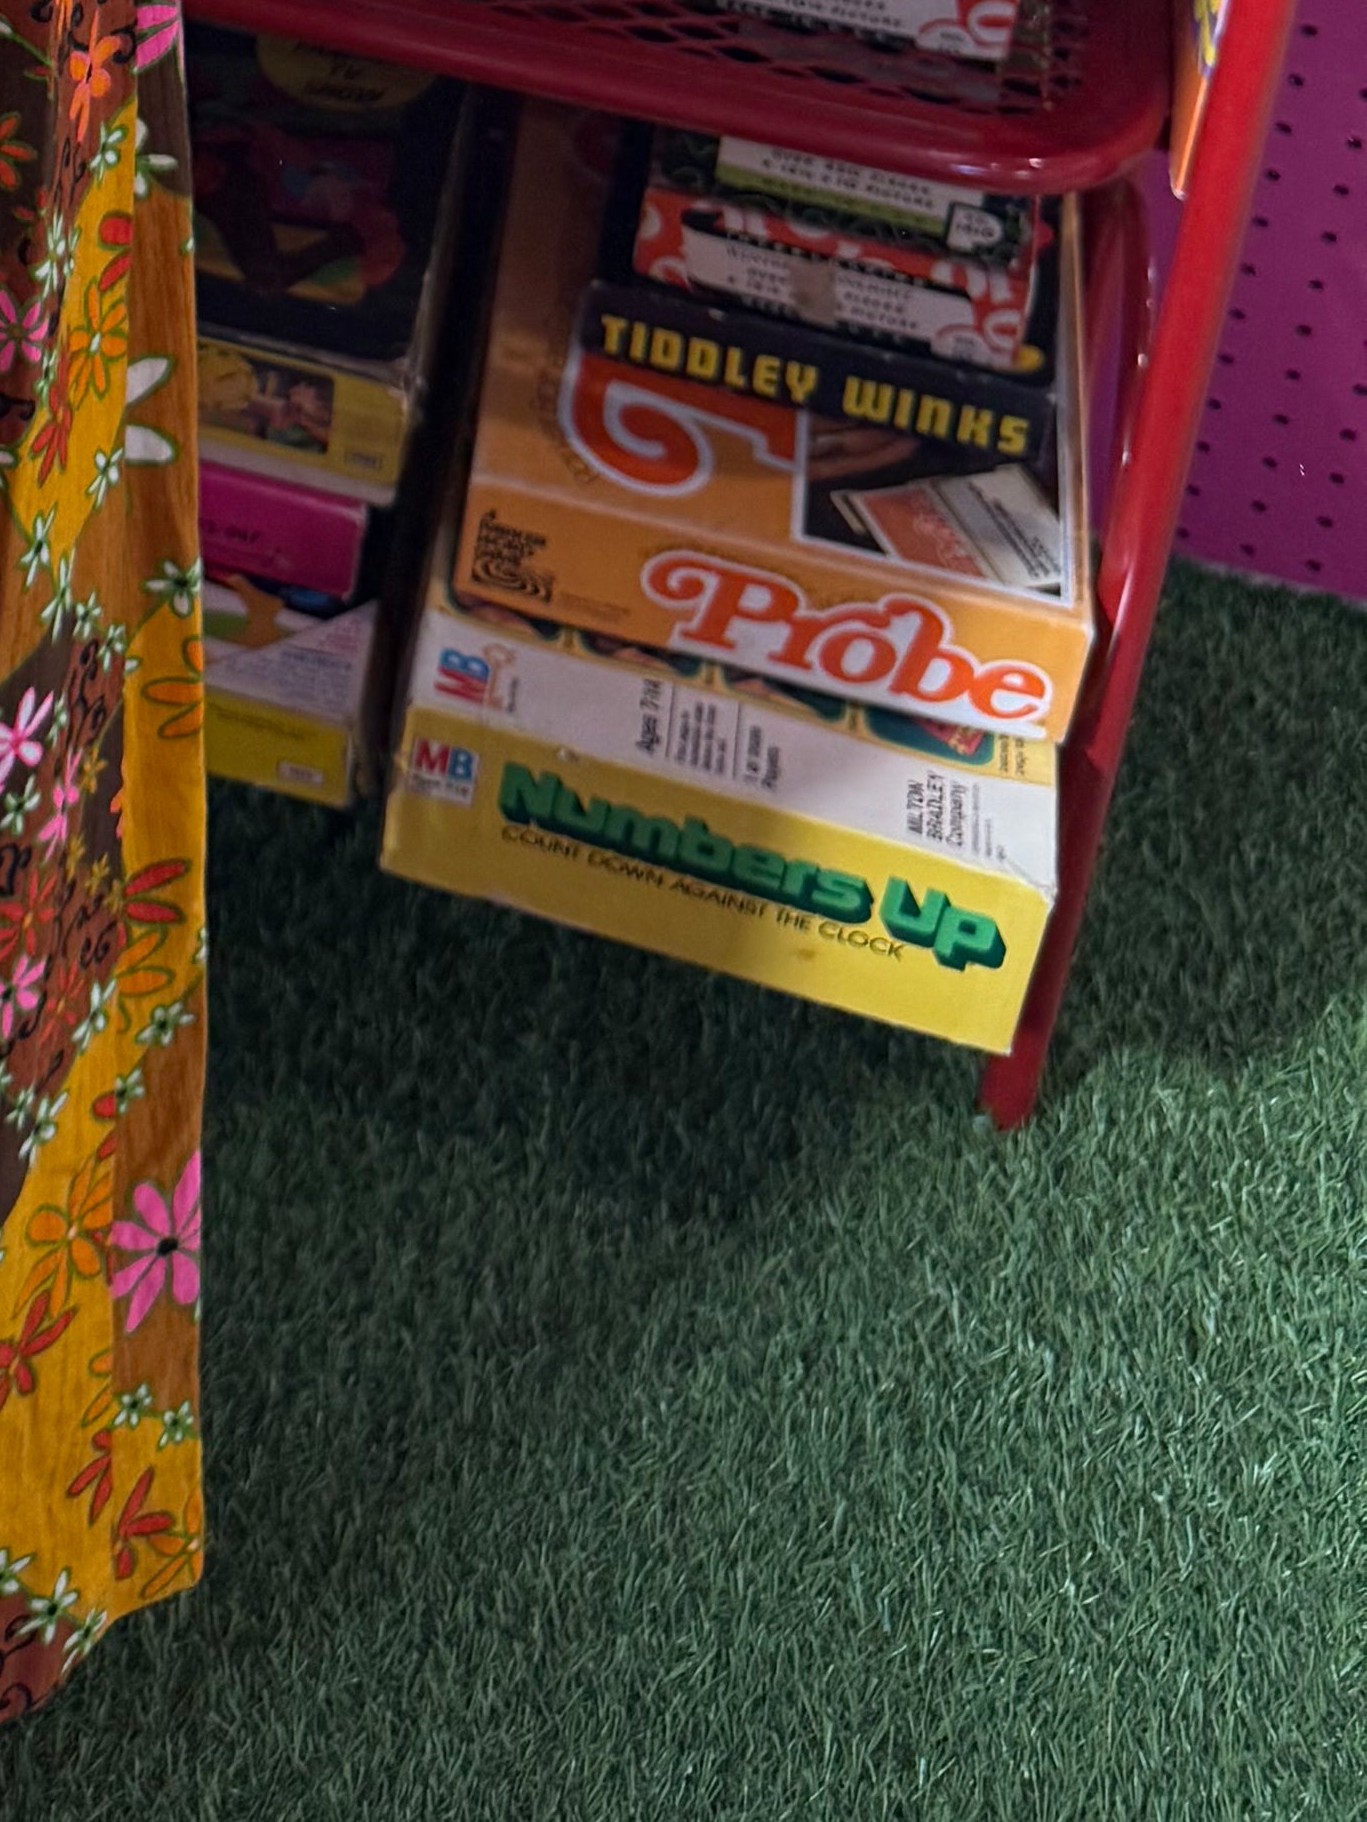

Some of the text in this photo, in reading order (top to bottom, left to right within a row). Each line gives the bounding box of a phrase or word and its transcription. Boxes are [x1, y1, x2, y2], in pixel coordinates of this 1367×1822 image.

[602, 314, 1029, 456] TIDDLEY WINKS
[646, 554, 1047, 721] Probe
[434, 649, 491, 704] MB
[415, 738, 476, 782] MB
[907, 779, 924, 835] MILTON
[926, 769, 945, 842] BRADLEY
[946, 780, 968, 847] Company
[498, 761, 875, 925] Numbers
[502, 824, 905, 962] COUNT DOWN AGAINST THE CLOCK
